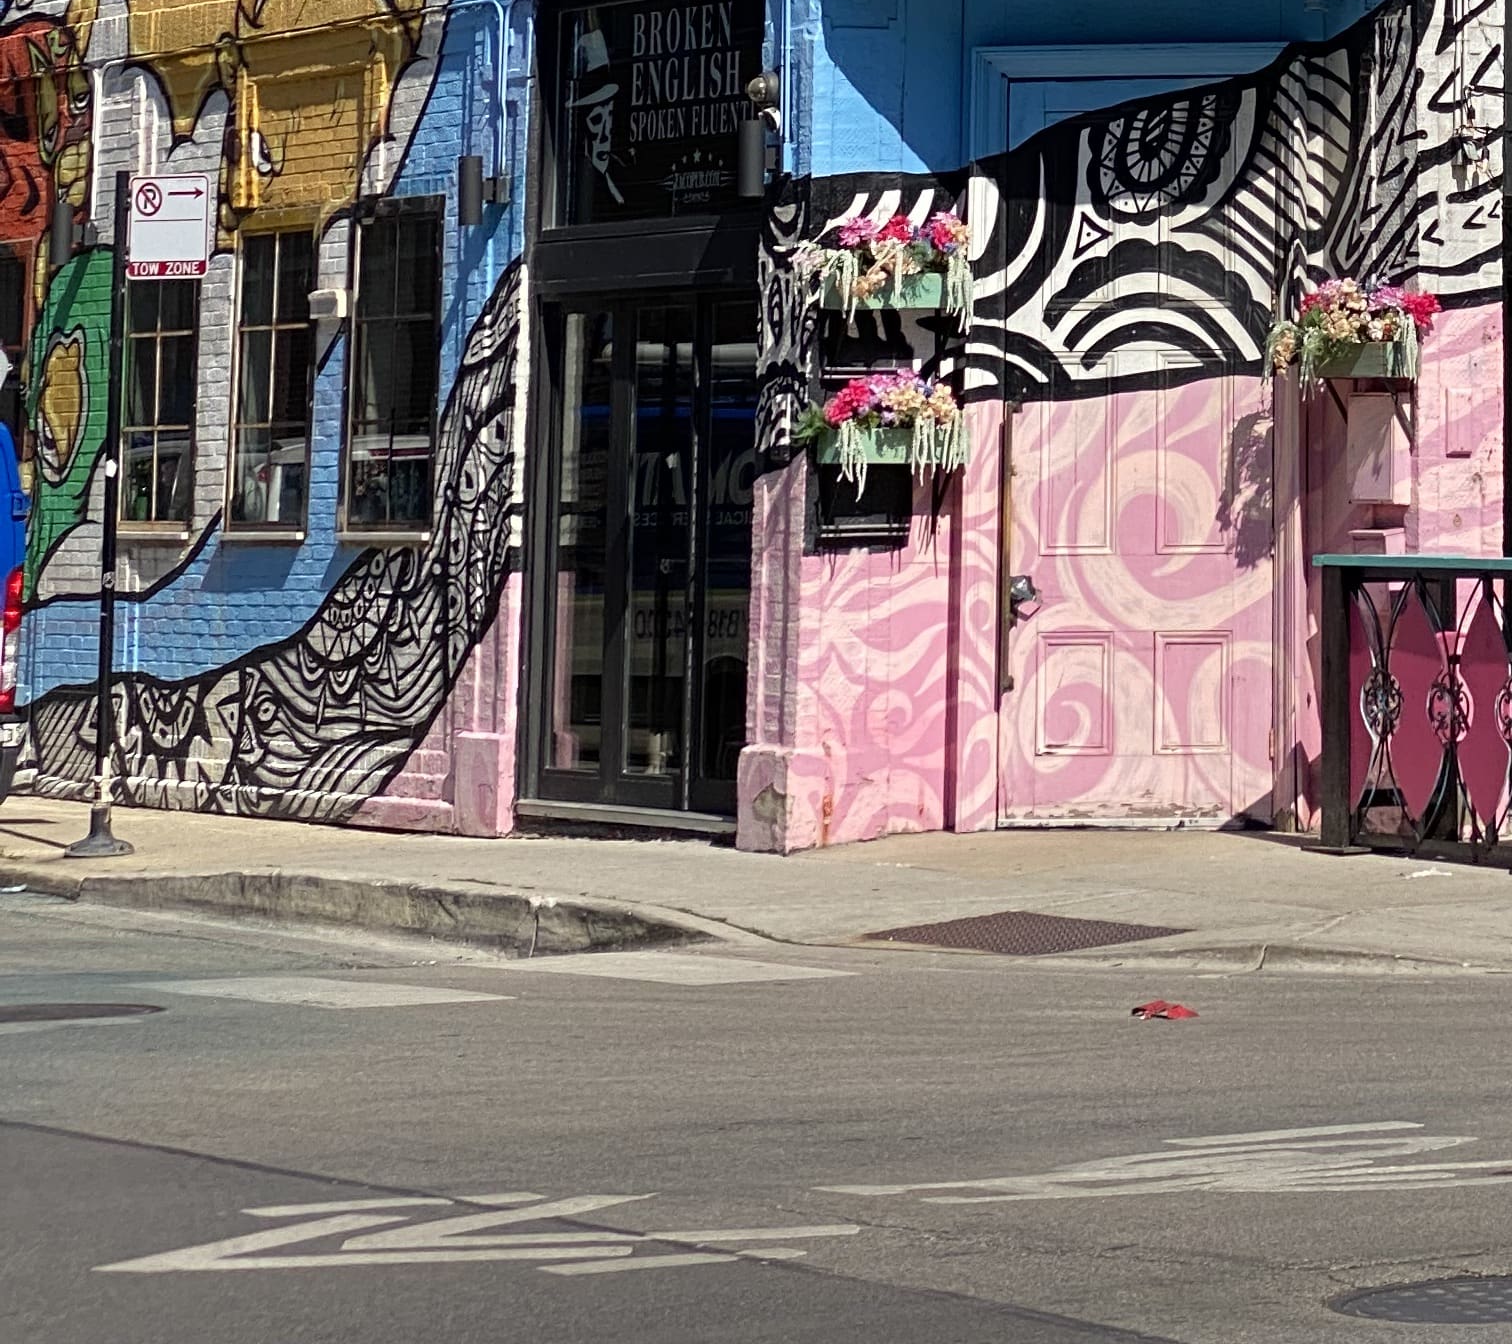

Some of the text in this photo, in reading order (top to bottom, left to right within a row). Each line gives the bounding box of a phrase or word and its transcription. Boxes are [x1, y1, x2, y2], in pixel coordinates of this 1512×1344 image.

[632, 0, 734, 57] BROKEN
[631, 50, 742, 107] ENGLISH
[629, 106, 686, 143] SPOKEN
[132, 261, 200, 275] TOW ZONE
